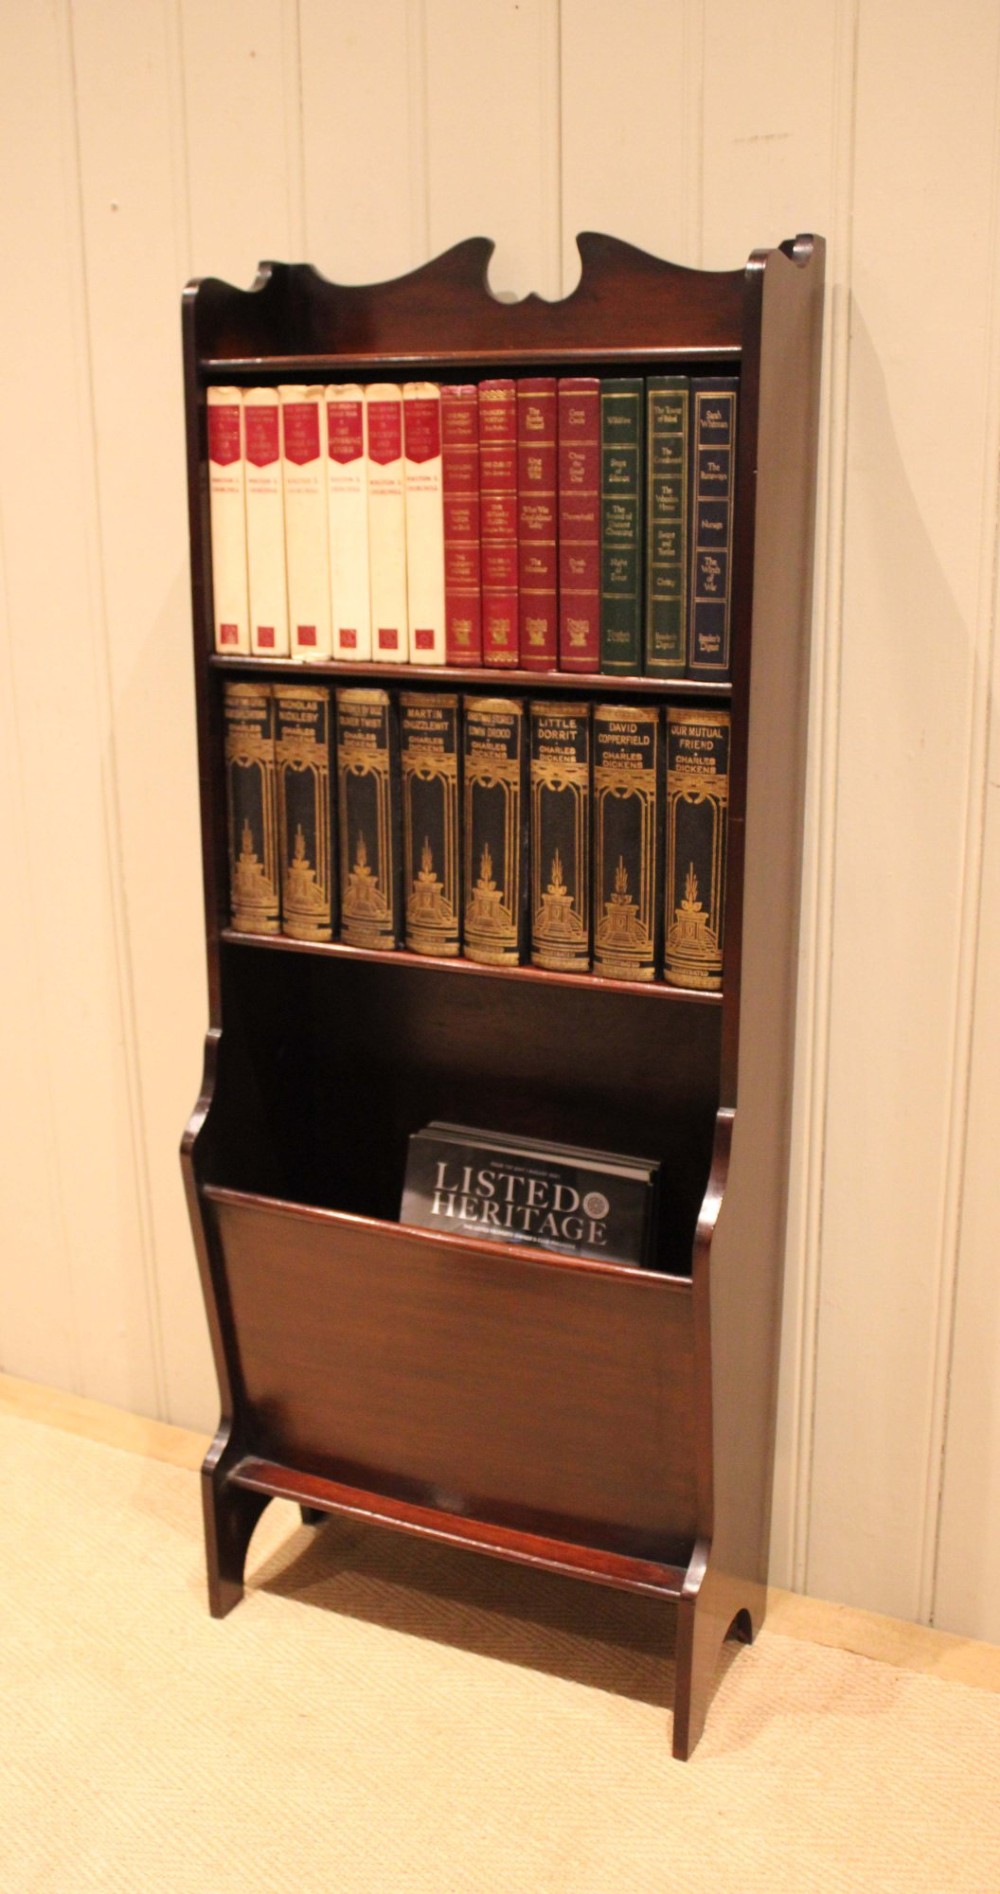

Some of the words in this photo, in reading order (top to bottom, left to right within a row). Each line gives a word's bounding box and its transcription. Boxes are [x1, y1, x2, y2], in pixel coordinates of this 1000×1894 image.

[707, 462, 720, 471] The
[704, 556, 717, 565] The
[407, 708, 443, 719] MARTIN
[538, 718, 577, 729] LITTLE
[609, 722, 638, 733] DAVID
[537, 728, 578, 740] DORRIT
[671, 725, 687, 736] OUR
[687, 726, 723, 738] MUTUAL
[408, 735, 444, 744] CHARLES
[598, 733, 650, 746] COPPERFIELD
[679, 739, 714, 750] FRIEND
[471, 741, 507, 751] CHARLES
[539, 745, 577, 755] CHARLES
[539, 754, 577, 763] DICKENS
[602, 751, 643, 761] CHARLES
[675, 755, 716, 765] CHARLES
[602, 759, 644, 769] DICKENS
[675, 764, 717, 774] DICKENS
[434, 1161, 581, 1213] LISTED
[430, 1190, 608, 1246] HERITAGE
